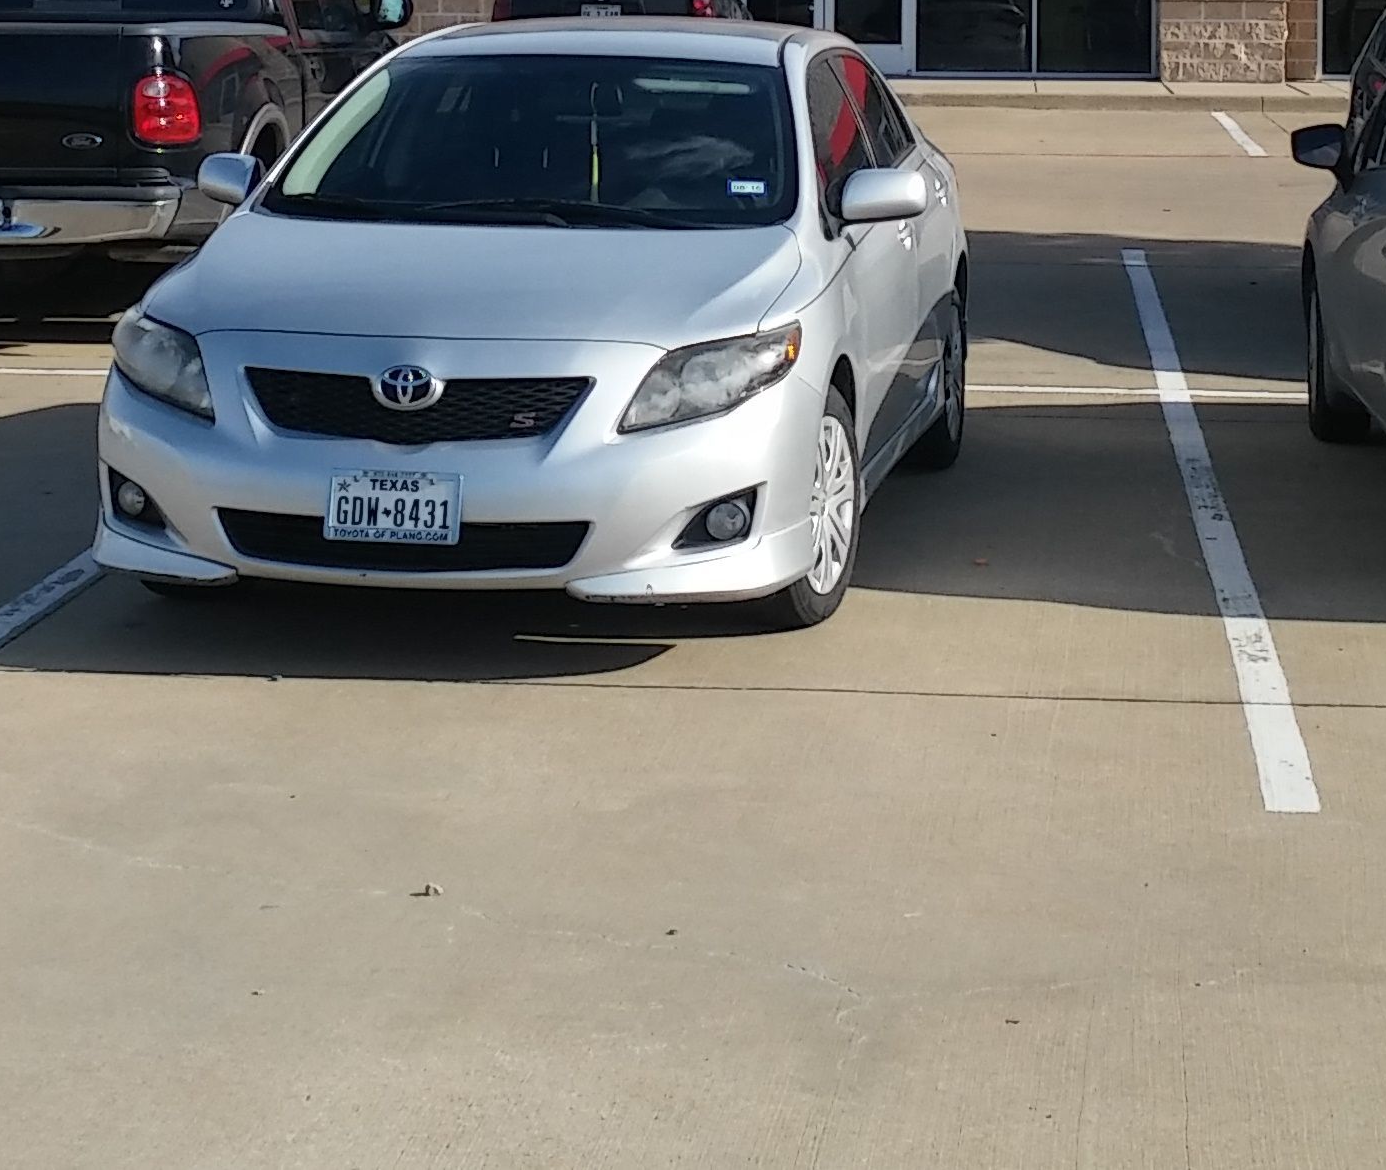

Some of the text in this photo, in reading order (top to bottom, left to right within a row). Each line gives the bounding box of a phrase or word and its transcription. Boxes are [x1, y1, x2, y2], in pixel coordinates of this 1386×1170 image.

[369, 478, 420, 492] TEXAS
[334, 528, 370, 537] TOYOTA
[373, 530, 386, 539] OF
